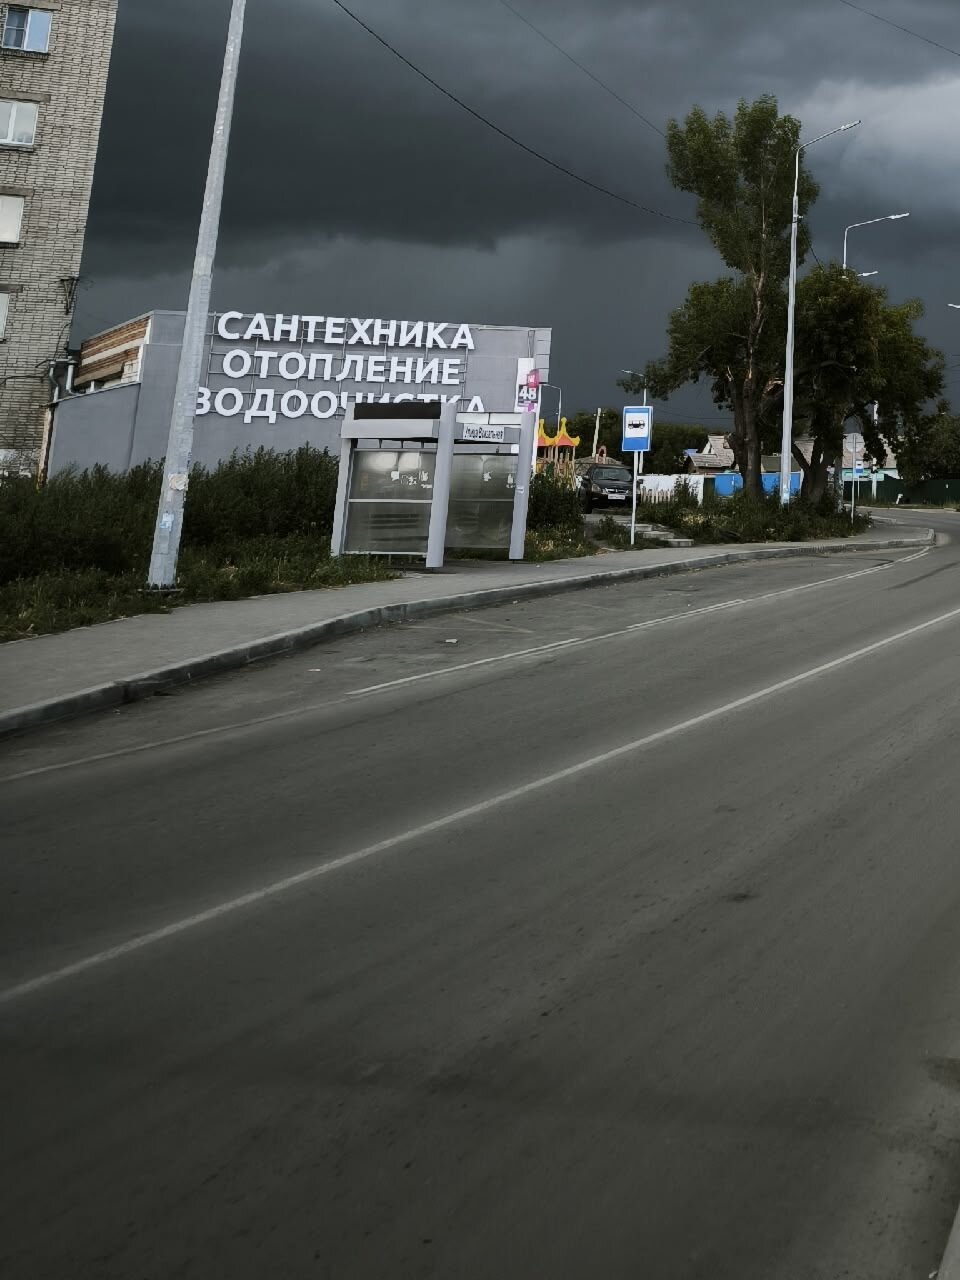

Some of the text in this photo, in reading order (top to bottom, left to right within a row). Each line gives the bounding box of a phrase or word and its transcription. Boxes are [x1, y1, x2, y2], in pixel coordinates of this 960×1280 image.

[217, 311, 475, 350] САНТЕХНИКА
[222, 348, 461, 385] ОТОПЛЕНИЕ
[519, 386, 537, 400] 48
